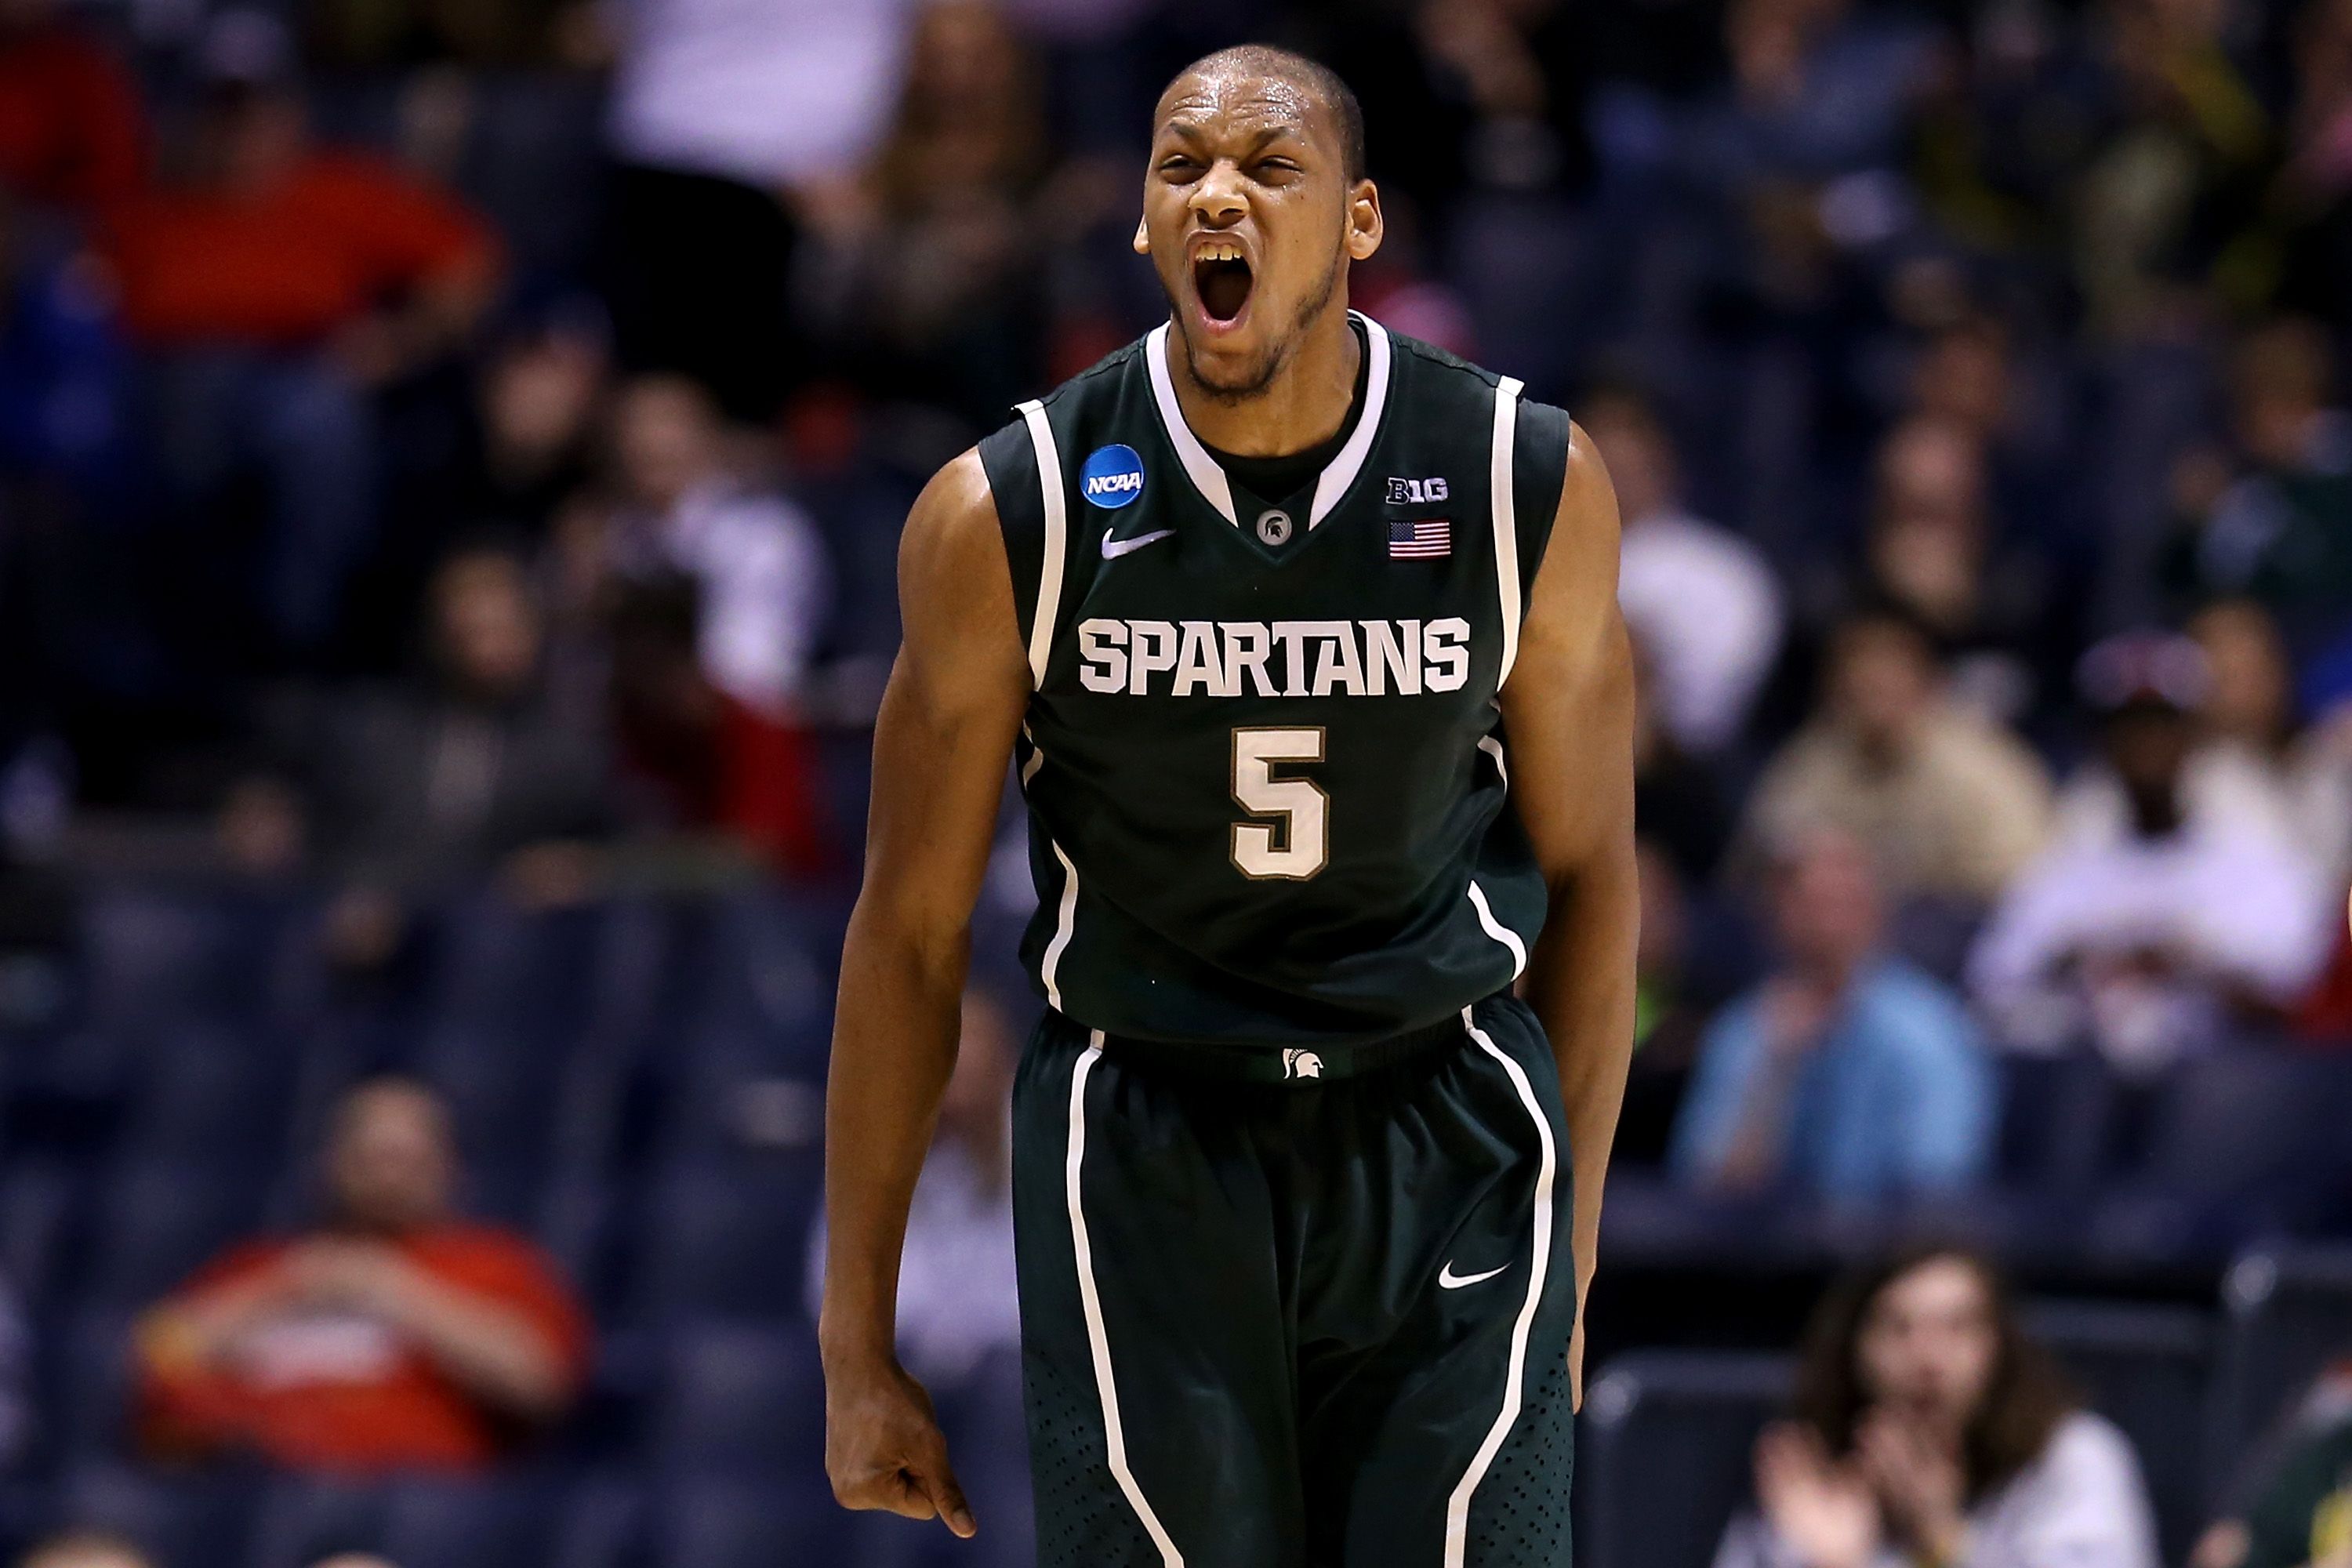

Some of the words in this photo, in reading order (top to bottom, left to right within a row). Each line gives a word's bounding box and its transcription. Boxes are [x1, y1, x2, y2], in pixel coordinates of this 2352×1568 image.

[1087, 472, 1142, 495] NCAA
[1079, 618, 1470, 696] SPARTANS
[1229, 725, 1330, 881] 5
